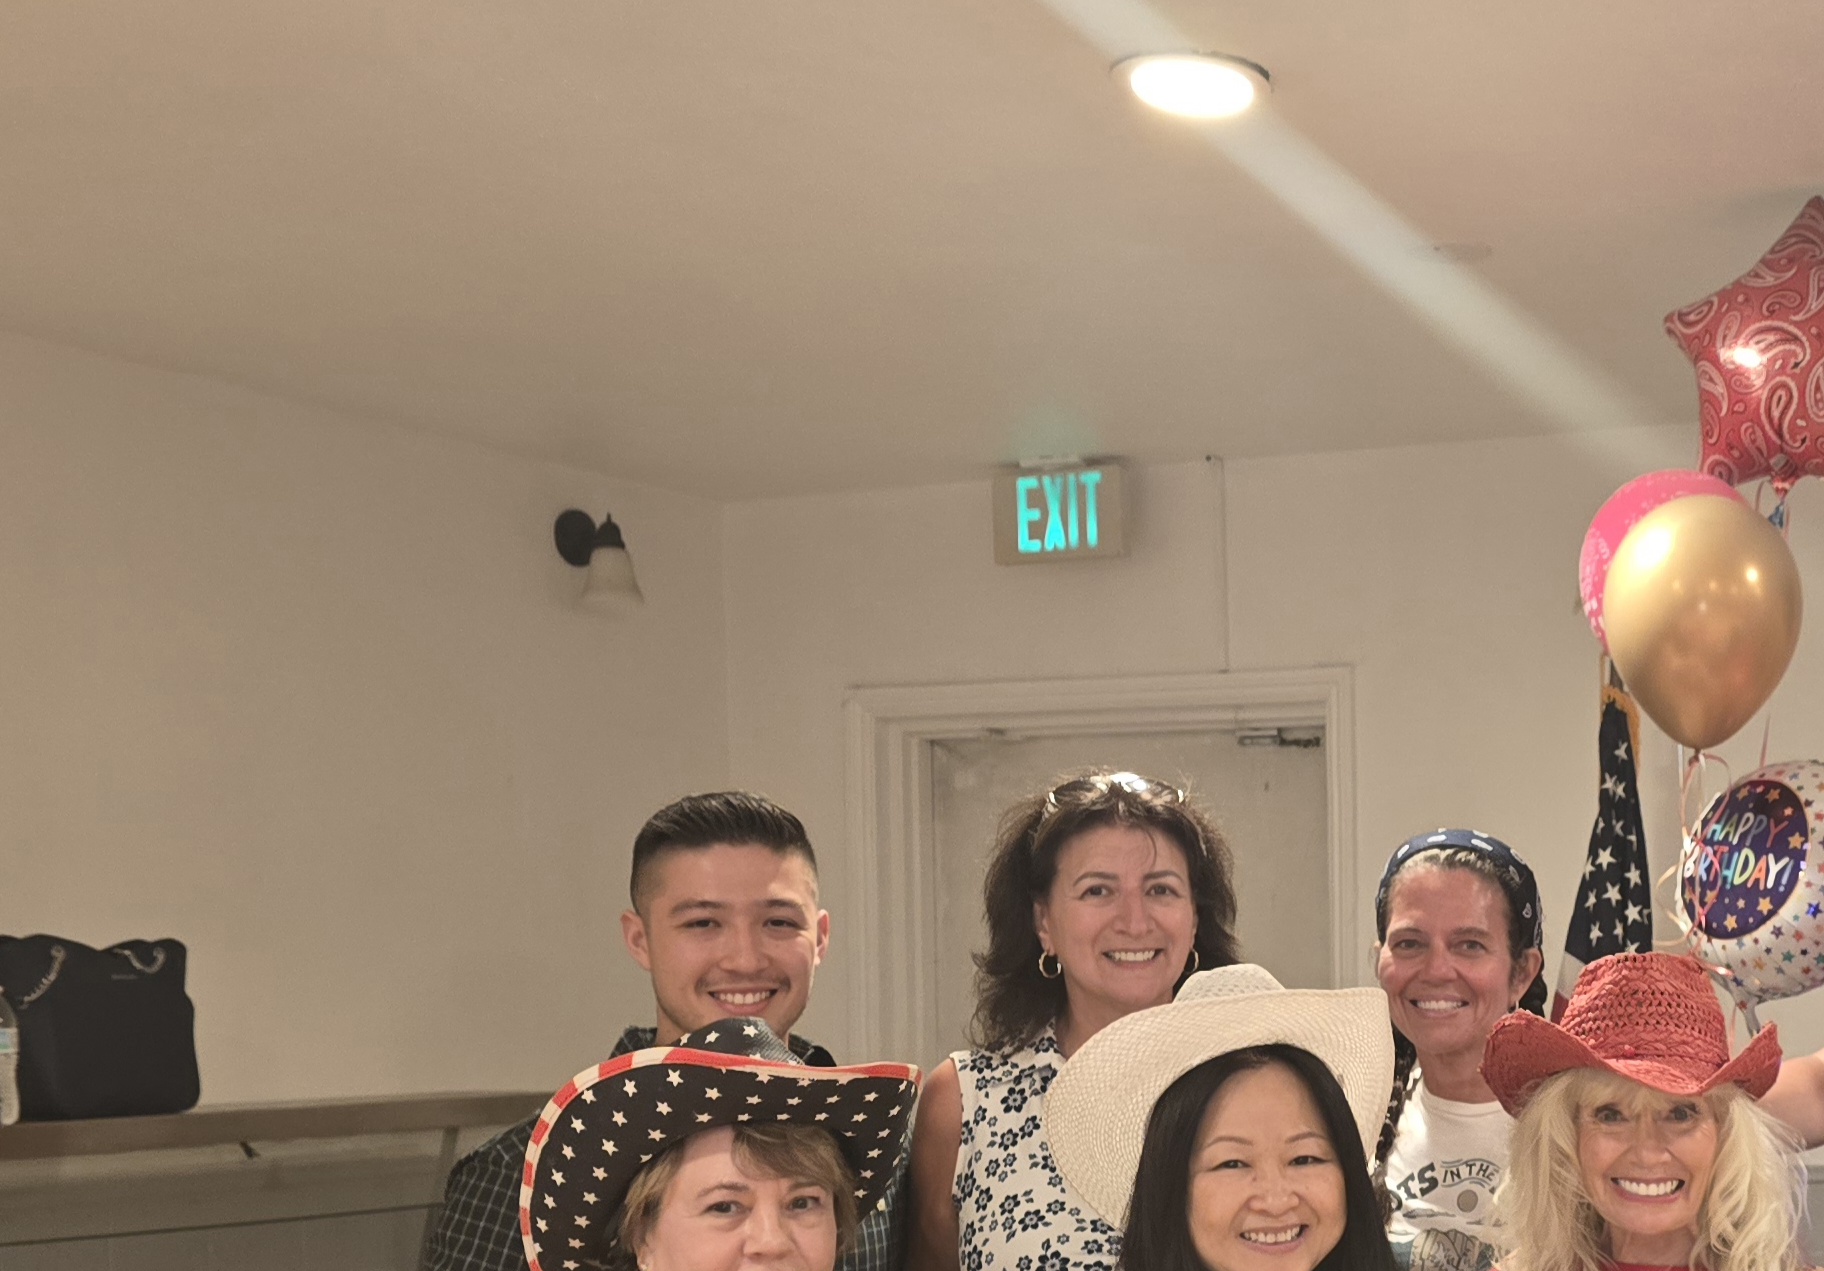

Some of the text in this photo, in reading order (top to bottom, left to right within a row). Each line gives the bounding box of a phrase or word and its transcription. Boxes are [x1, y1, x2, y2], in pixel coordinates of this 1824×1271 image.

[1016, 471, 1103, 553] EXIT
[1706, 808, 1790, 848] HAPPY
[1442, 1168, 1462, 1184] IN
[1466, 1161, 1500, 1182] THE
